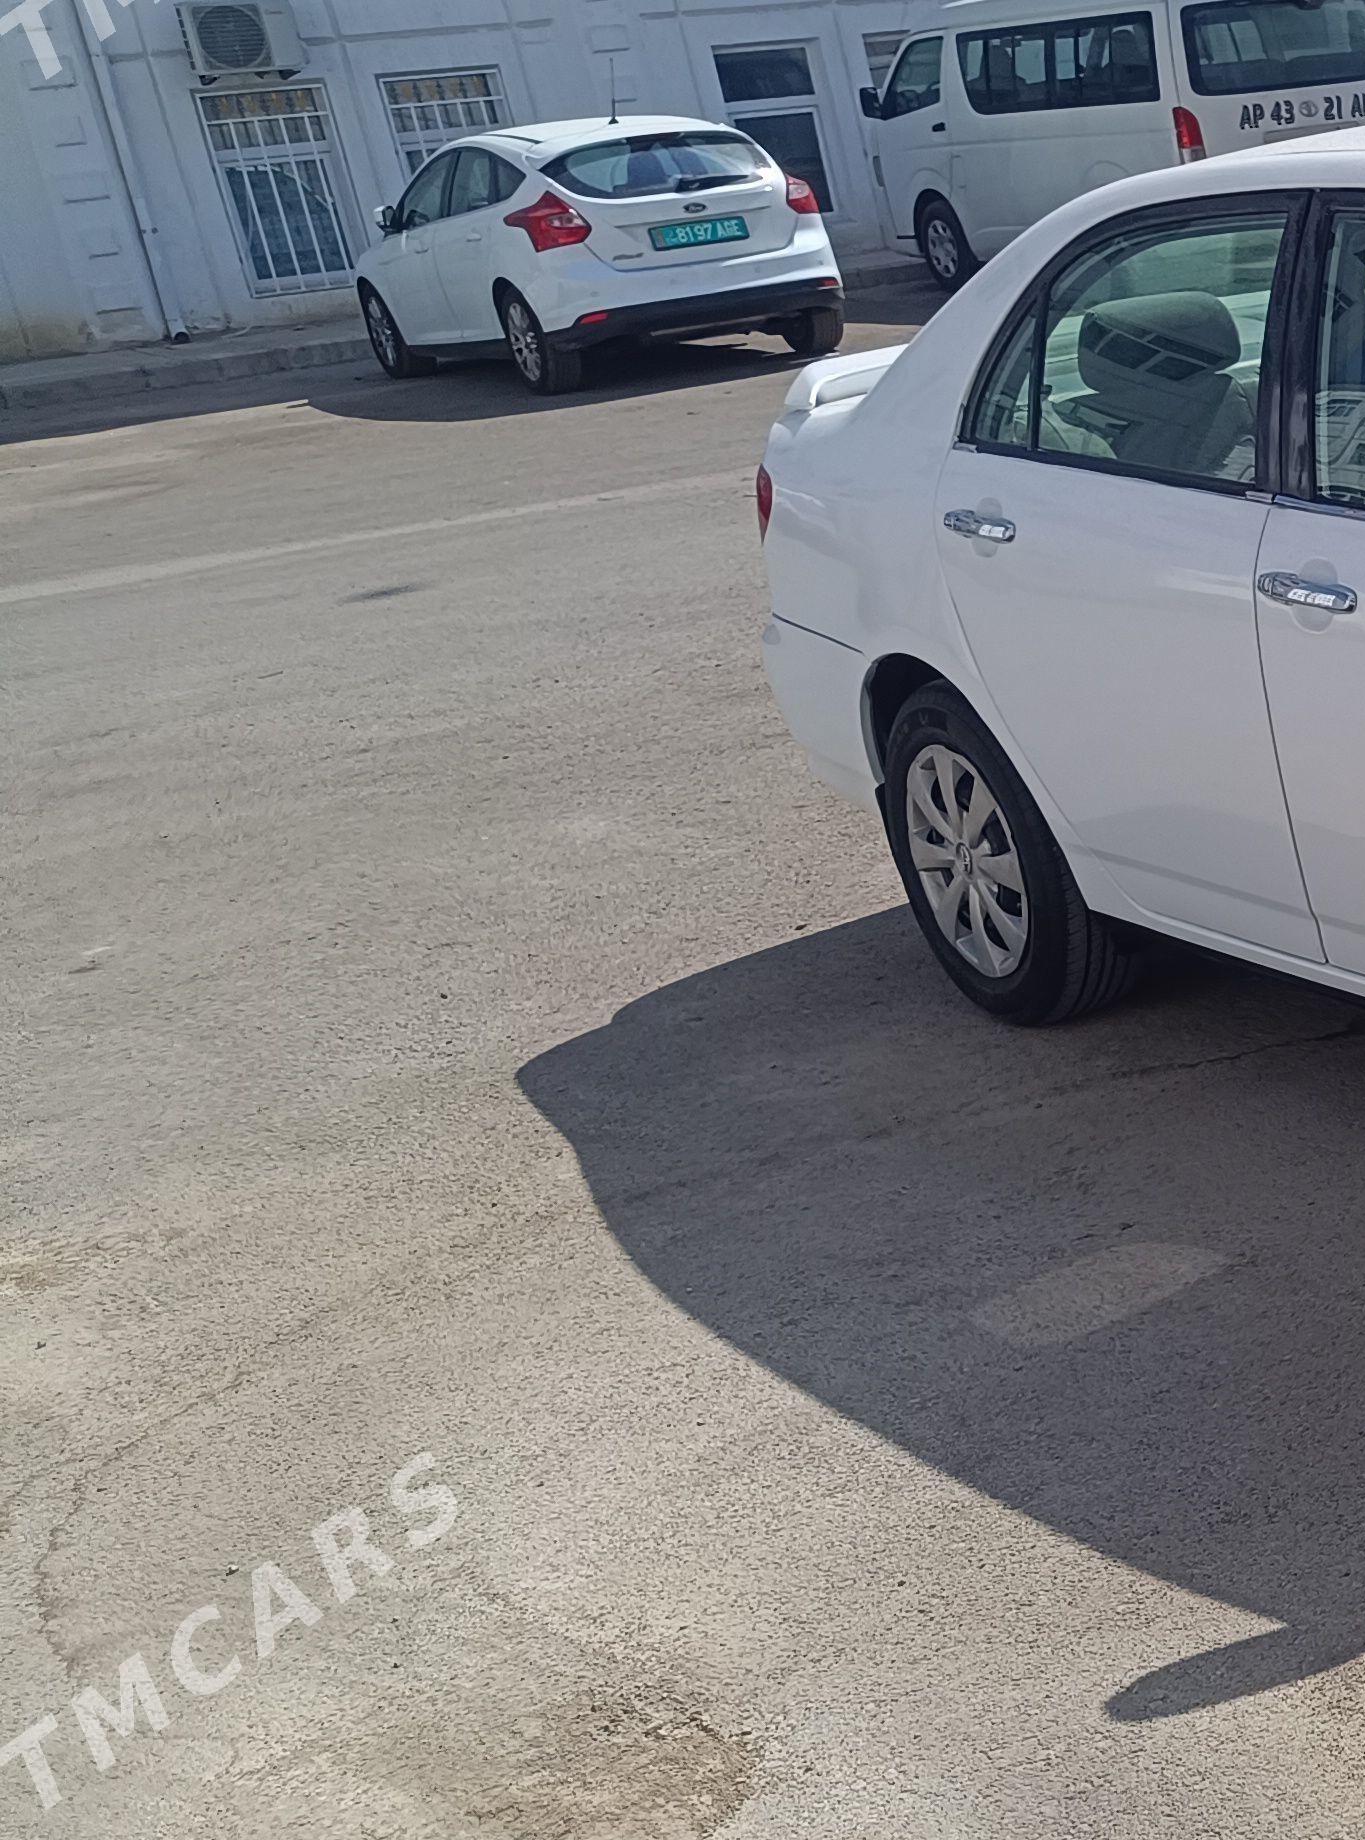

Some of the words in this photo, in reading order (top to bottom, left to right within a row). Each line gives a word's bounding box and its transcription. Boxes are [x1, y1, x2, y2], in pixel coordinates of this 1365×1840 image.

[1239, 103, 1265, 130] AP
[1270, 100, 1296, 126] 43
[1323, 95, 1344, 121] 21
